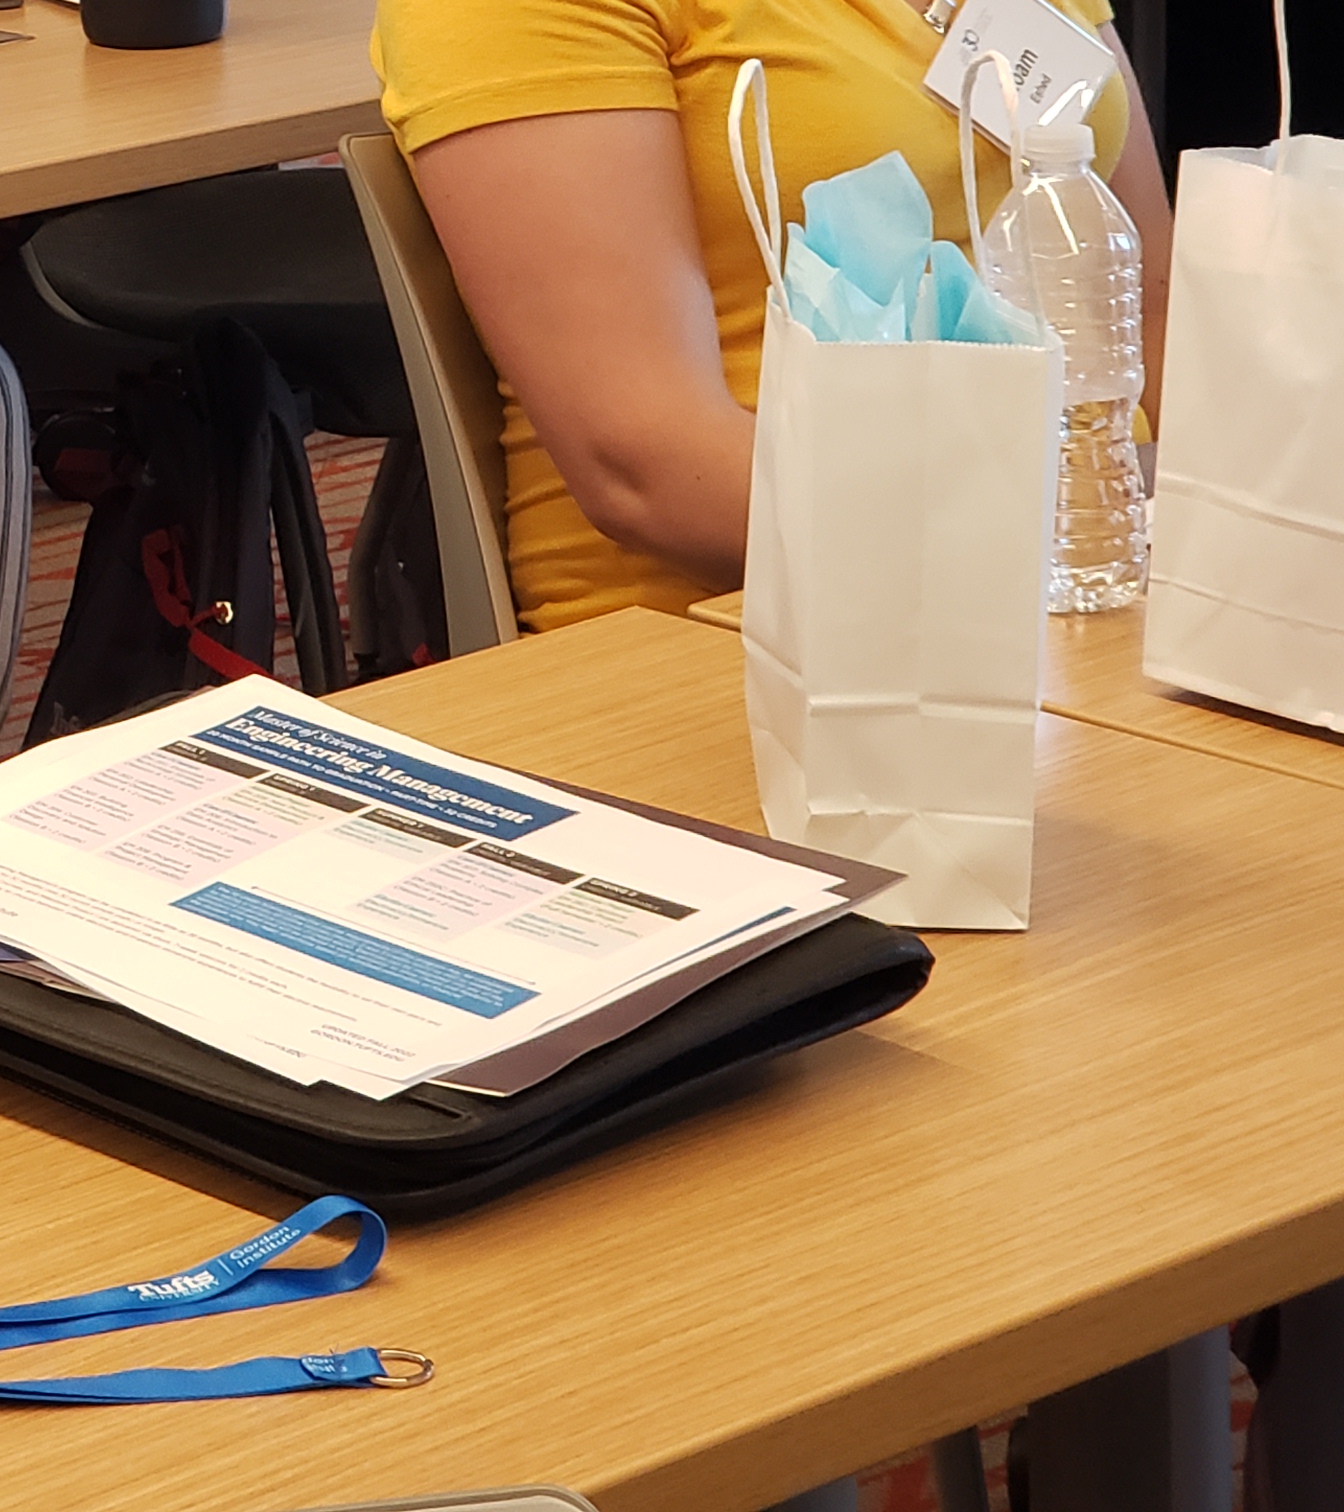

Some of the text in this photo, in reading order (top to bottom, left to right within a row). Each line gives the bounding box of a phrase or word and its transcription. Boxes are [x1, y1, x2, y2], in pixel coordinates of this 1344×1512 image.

[1012, 49, 1039, 91] oam
[251, 710, 303, 732] Master
[224, 717, 375, 774] Engineering
[367, 763, 534, 825] Management
[229, 1226, 290, 1261] Gordon
[235, 1228, 301, 1269] Institute
[127, 1269, 216, 1299] Tufts
